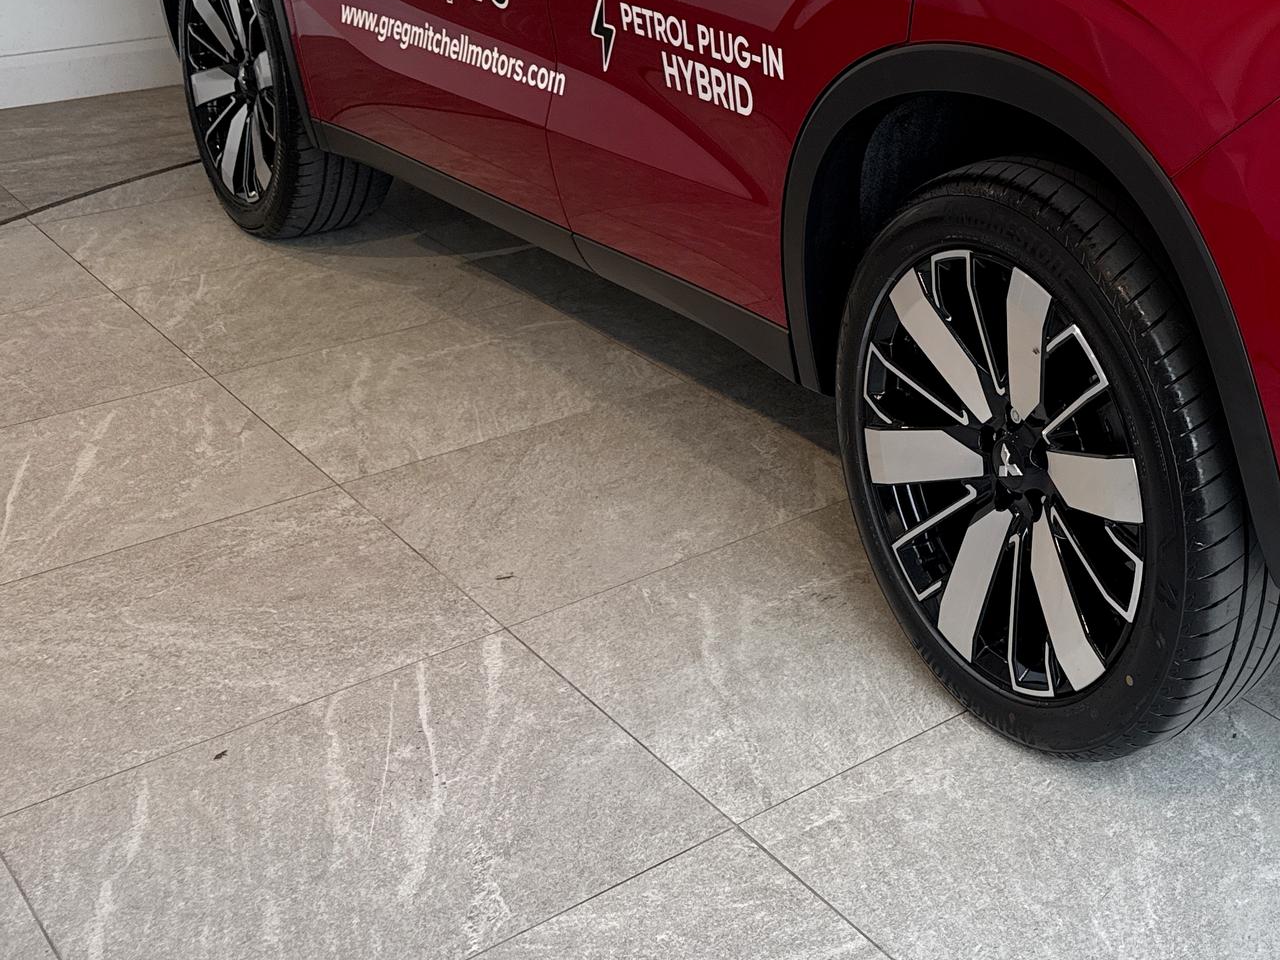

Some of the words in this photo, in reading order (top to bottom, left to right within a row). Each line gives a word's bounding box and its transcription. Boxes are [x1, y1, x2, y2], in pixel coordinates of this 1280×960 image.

[341, 4, 566, 96] www.gregmitchellmotors.com
[620, 2, 694, 52] PETROL
[697, 23, 785, 81] PLUG-IN
[661, 51, 753, 117] HYBRID
